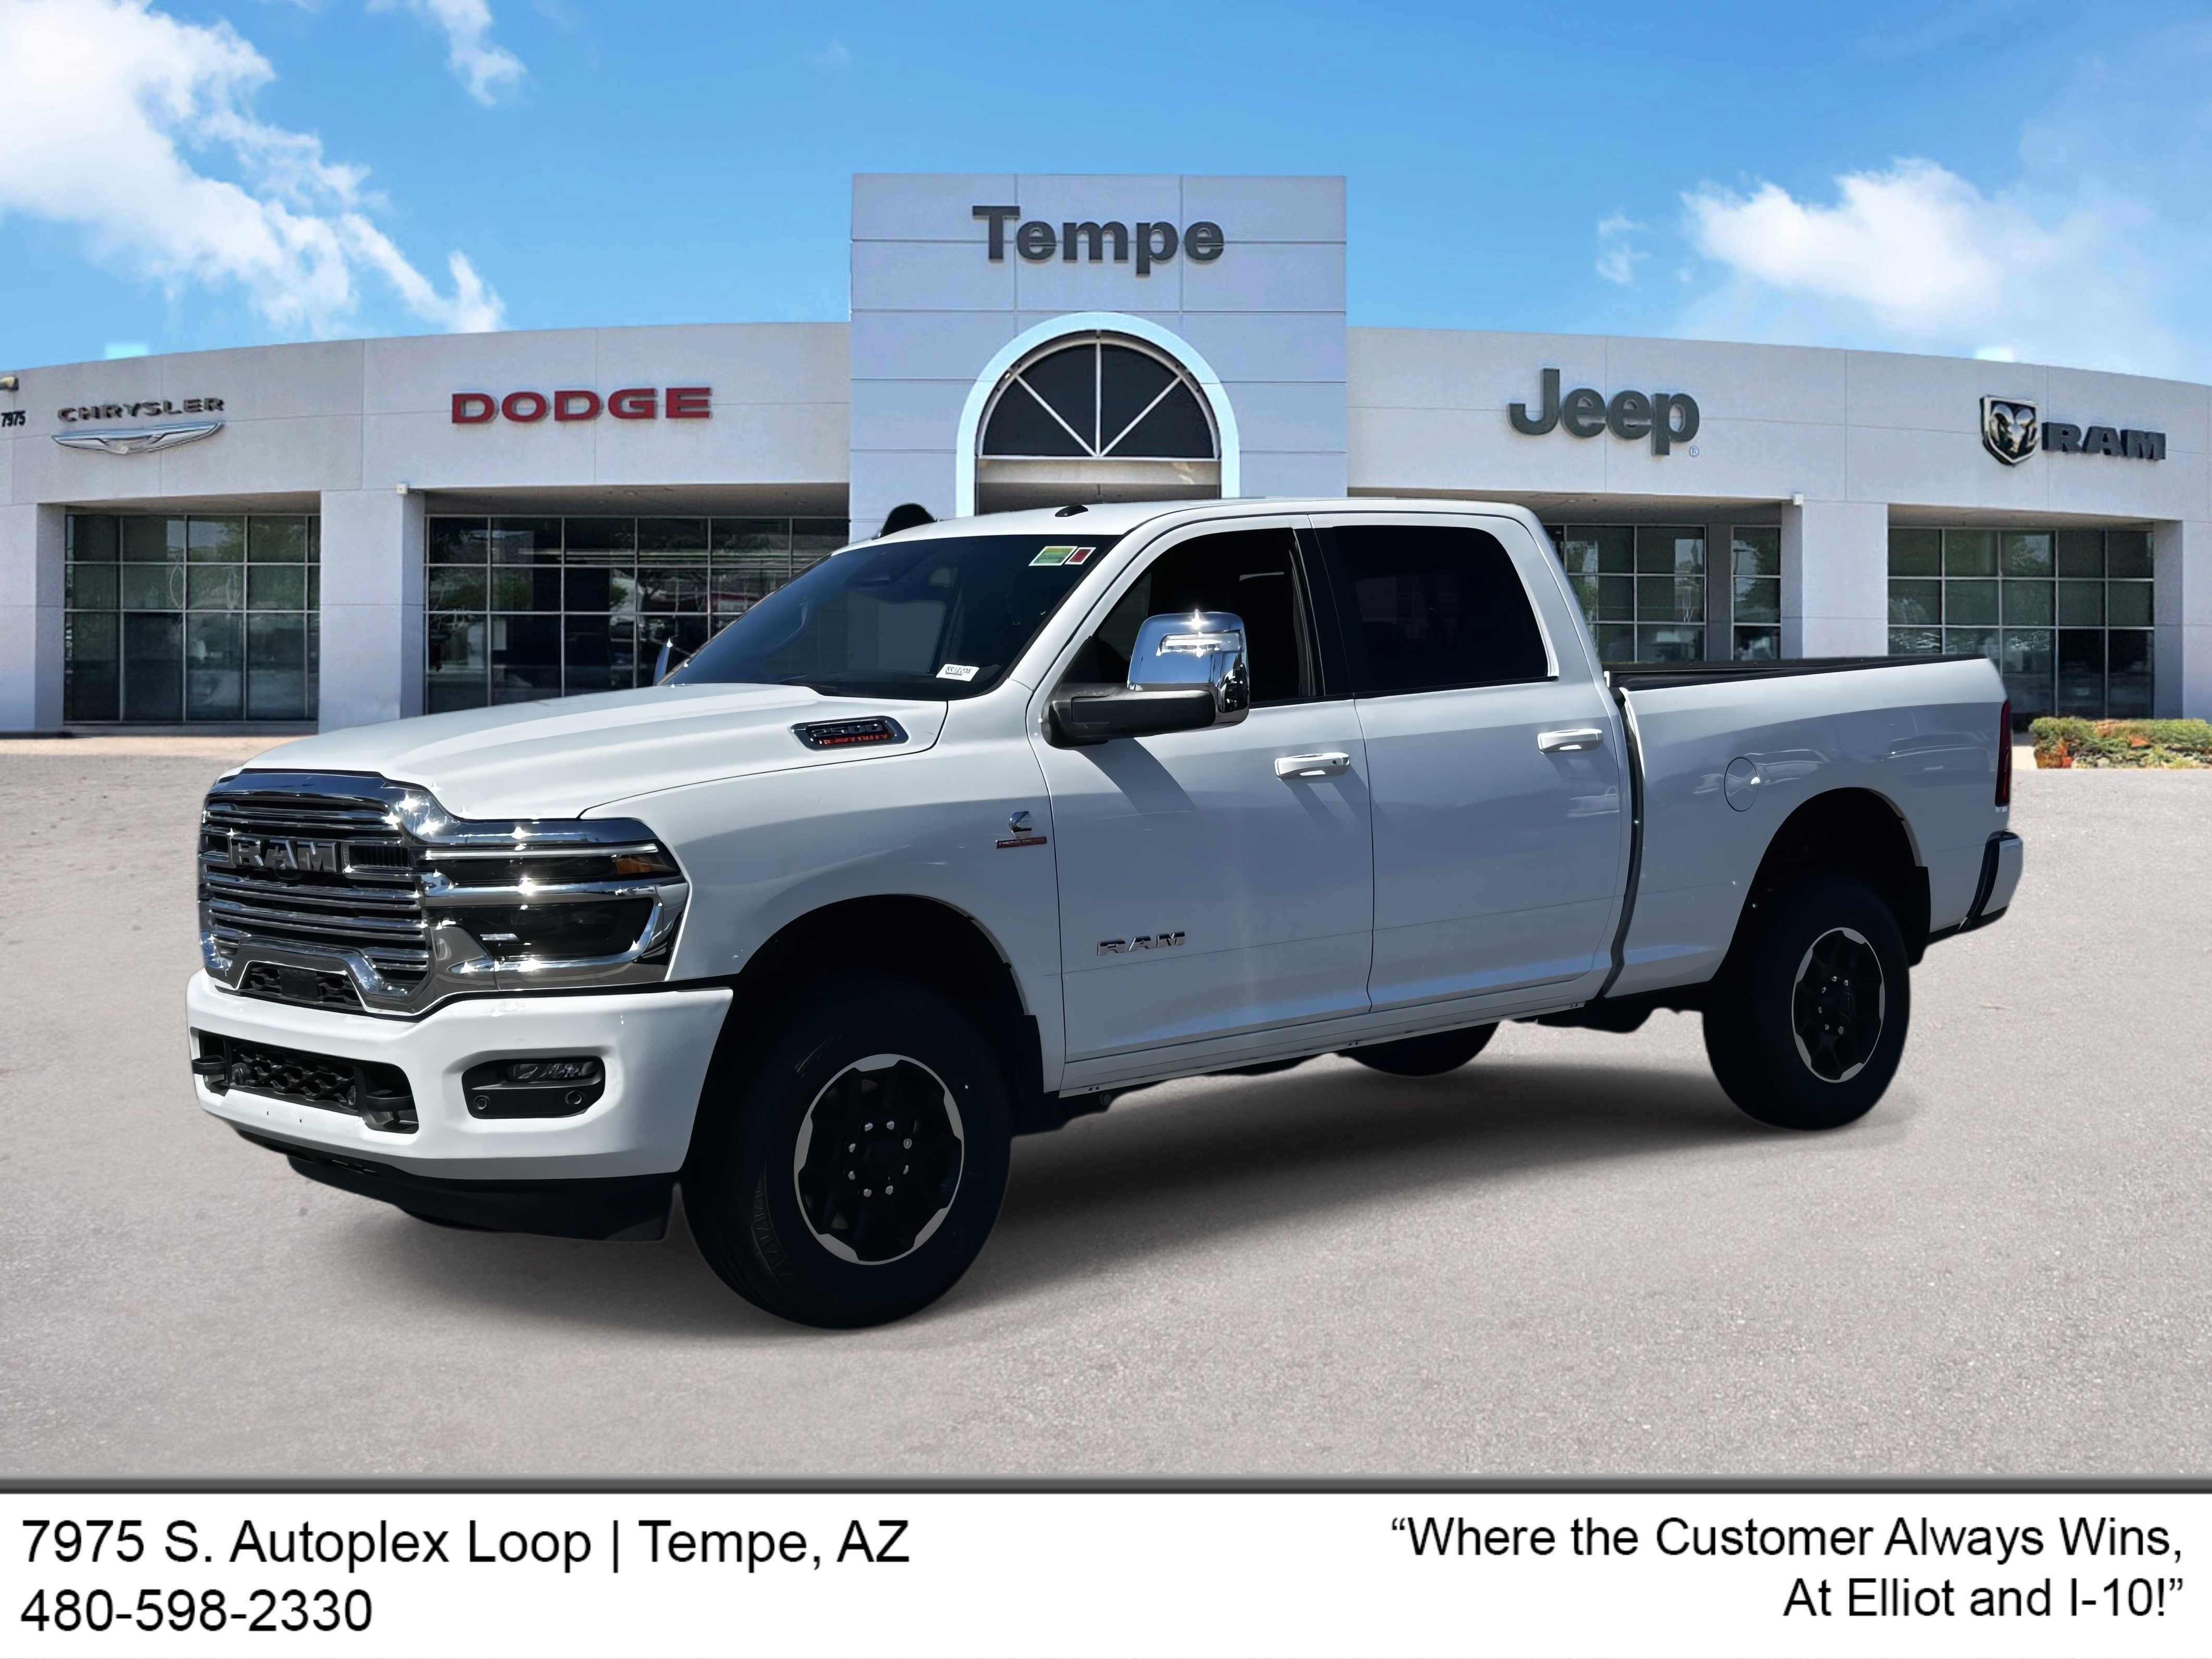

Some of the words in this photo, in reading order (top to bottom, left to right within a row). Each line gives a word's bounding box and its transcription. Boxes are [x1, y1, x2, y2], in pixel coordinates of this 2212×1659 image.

[972, 205, 1224, 276] Tempe
[2, 410, 26, 428] 7975
[57, 397, 224, 422] CHRYSLER
[451, 387, 712, 423] DODGE
[1508, 368, 1700, 456] Jeep
[2041, 421, 2166, 460] RAM
[229, 835, 338, 874] RAM
[1097, 931, 1186, 956] RAM
